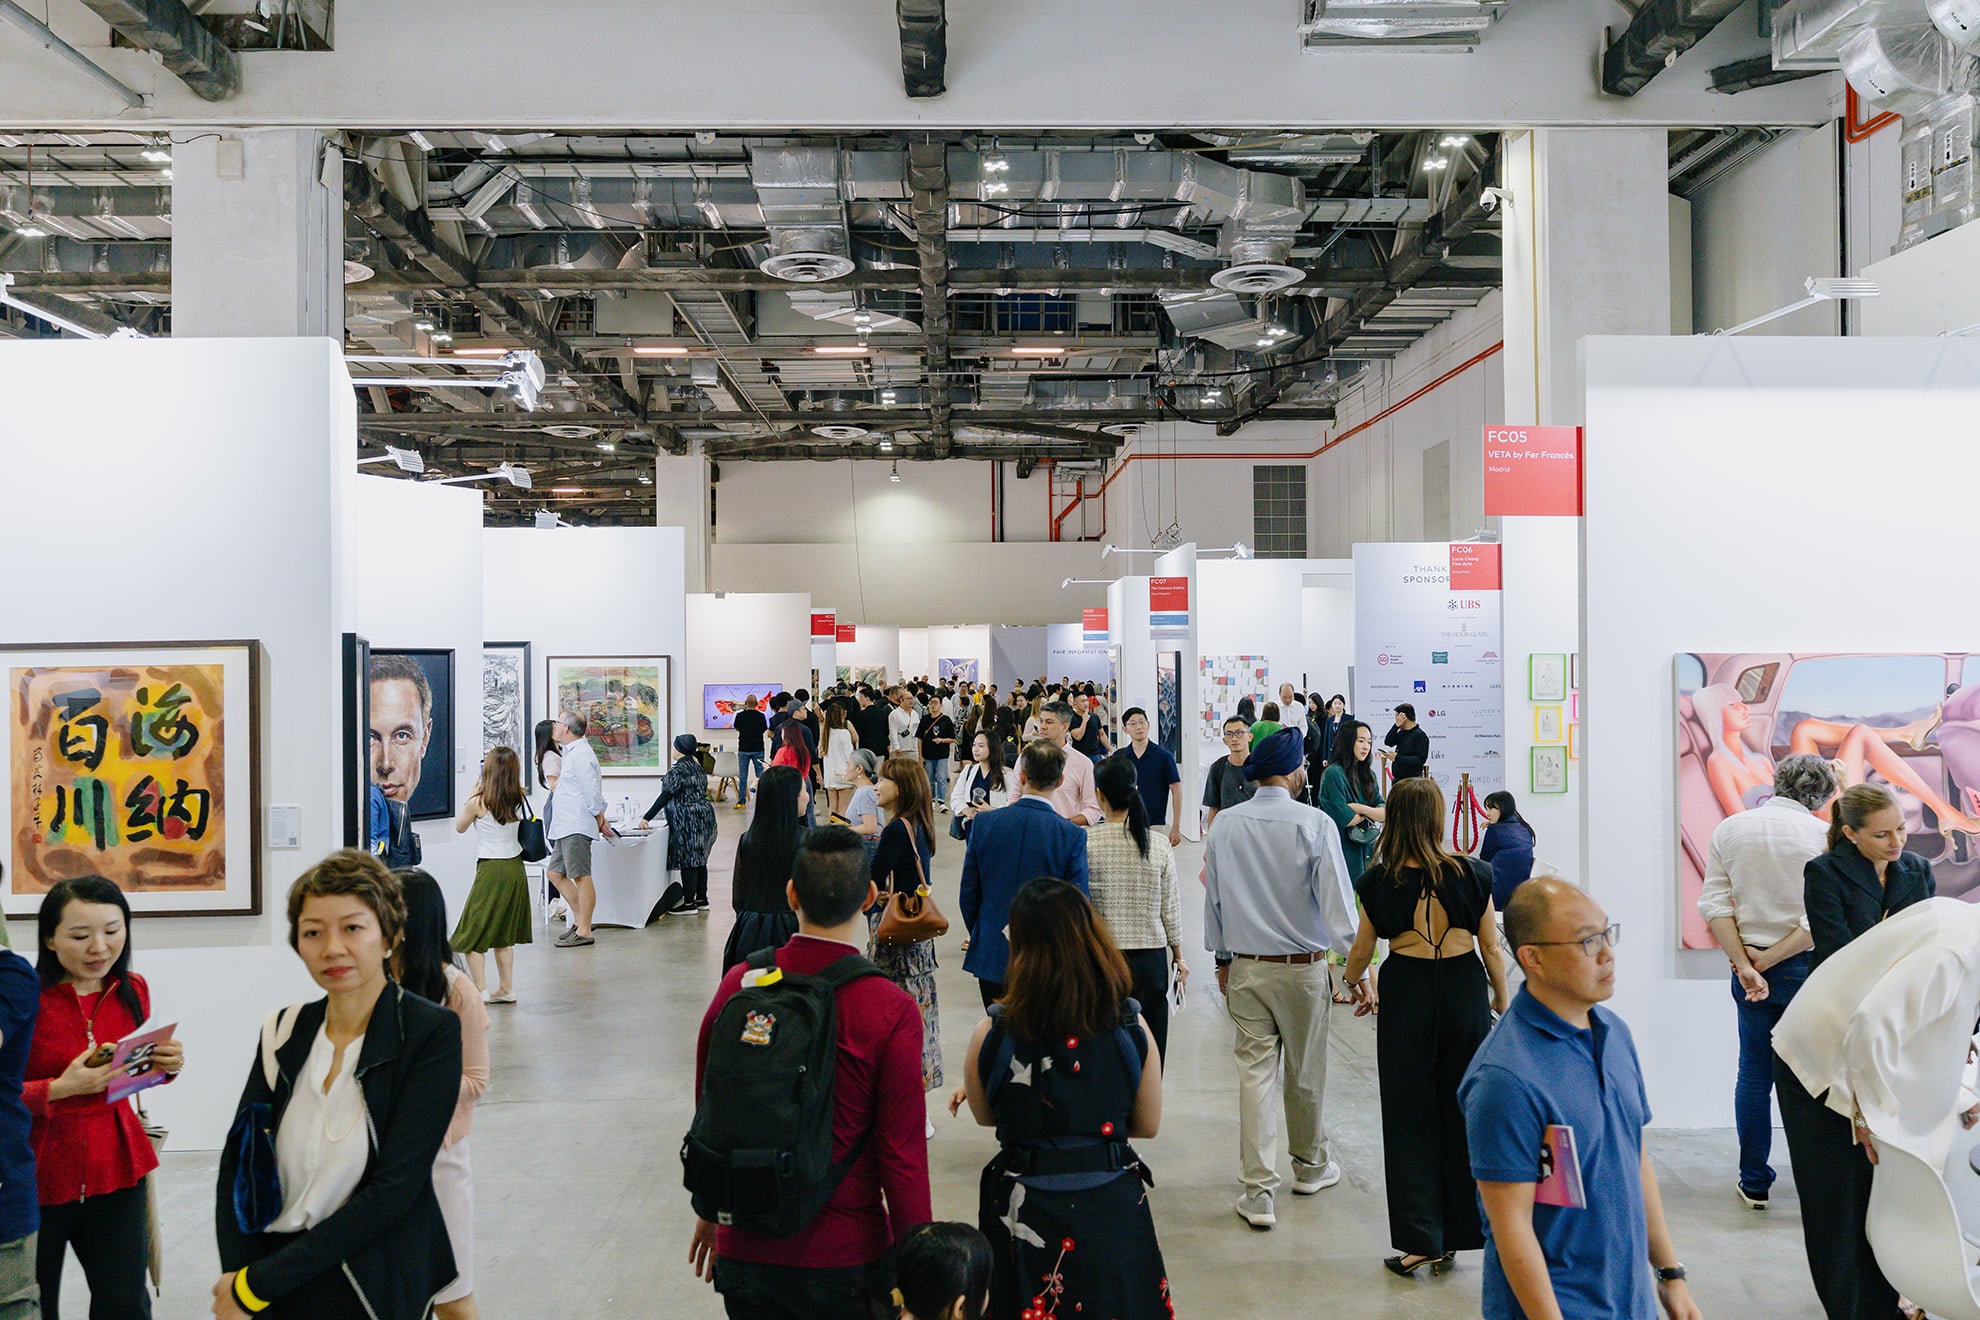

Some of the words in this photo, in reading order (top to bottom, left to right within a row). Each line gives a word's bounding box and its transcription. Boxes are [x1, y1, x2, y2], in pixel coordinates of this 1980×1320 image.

[1488, 430, 1527, 443] FC05
[1488, 451, 1511, 459] VETA
[1513, 450, 1523, 460] by
[1525, 451, 1539, 459] Fer
[1541, 451, 1574, 459] Francés
[1460, 600, 1481, 609] UBS
